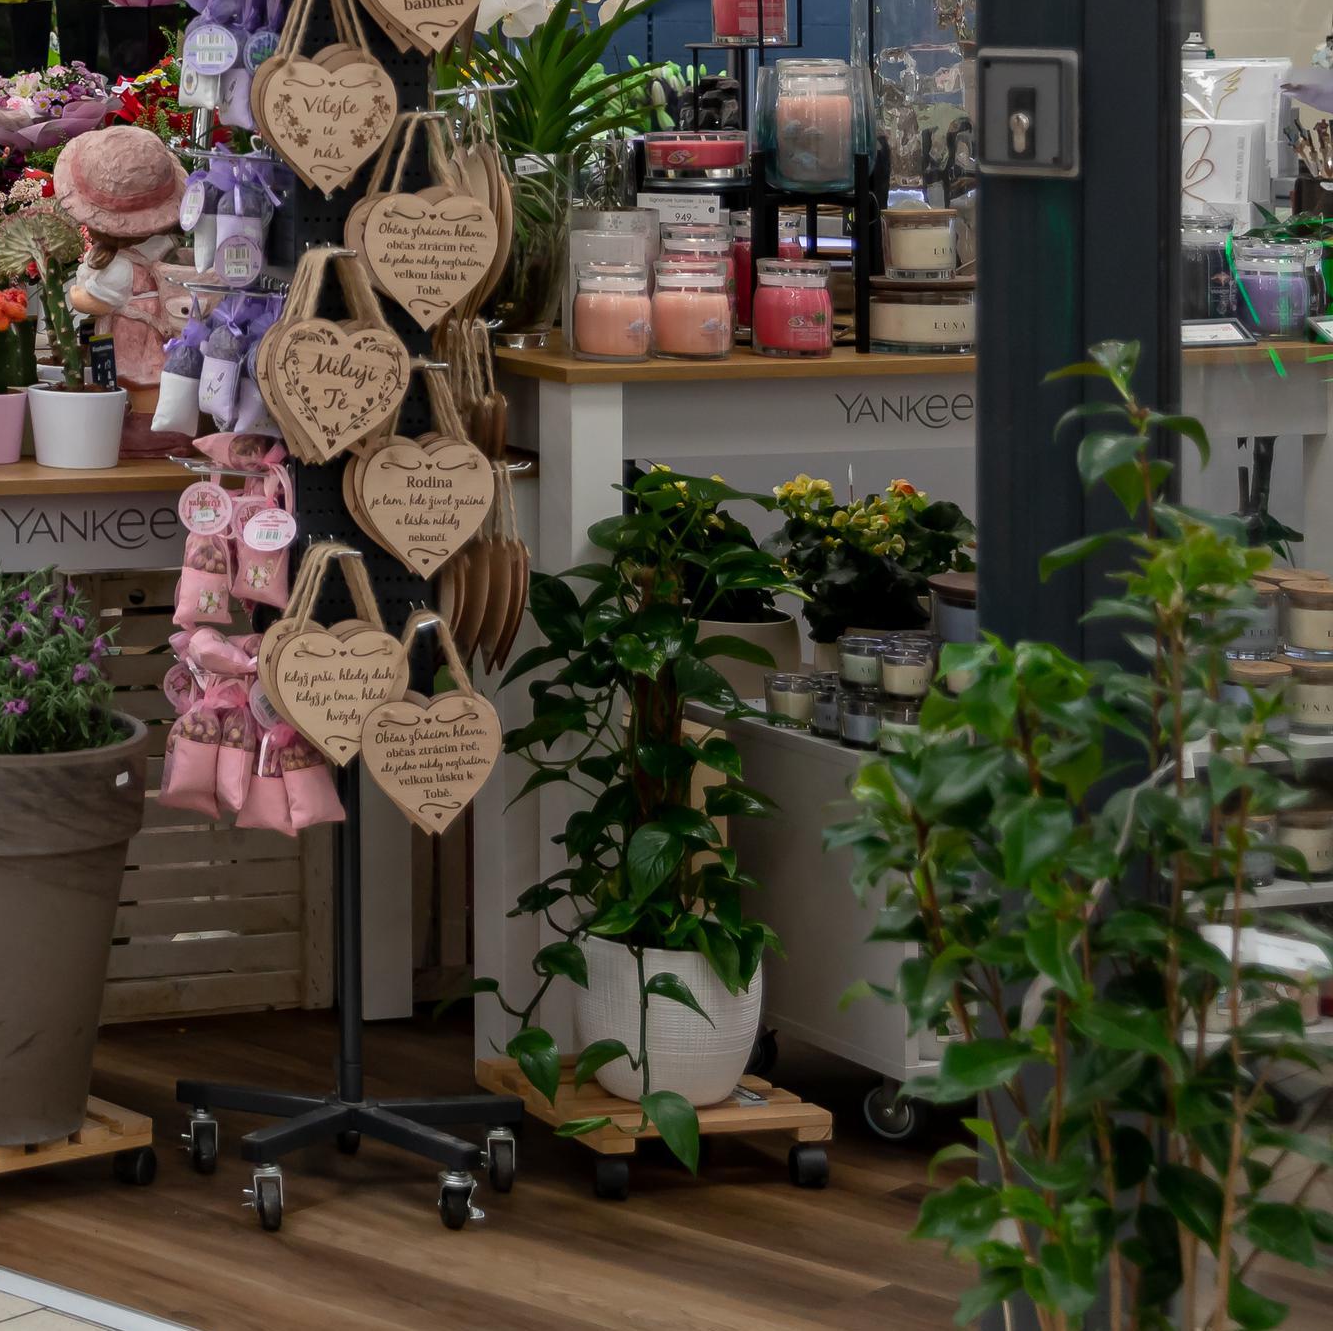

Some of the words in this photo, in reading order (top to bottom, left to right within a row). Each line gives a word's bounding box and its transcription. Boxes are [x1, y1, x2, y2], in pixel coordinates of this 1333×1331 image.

[303, 94, 360, 121] Vítejte
[323, 126, 336, 136] u
[313, 143, 345, 159] nás
[379, 222, 410, 235] Občas
[411, 224, 453, 241] ztrácím
[386, 240, 415, 250] občas
[418, 241, 457, 252] ztrácím
[416, 254, 440, 269] nikdy
[394, 270, 428, 280] velkou
[430, 270, 457, 281] lásku
[460, 272, 467, 281] k
[307, 354, 377, 389] Miluji
[323, 388, 349, 410] Tě
[406, 476, 453, 488] Rodina
[369, 497, 381, 510] je
[409, 493, 427, 506] kde
[428, 494, 453, 510] život
[453, 495, 486, 510] začíná
[404, 513, 430, 525] láska
[432, 513, 460, 530] nikdy
[284, 671, 309, 686] Když
[339, 667, 369, 684] hledej
[371, 667, 395, 680] duh
[296, 690, 321, 706] Když
[321, 692, 332, 706] je
[361, 687, 387, 701] hled
[375, 731, 407, 744] Občas
[408, 729, 451, 745] ztrácím
[386, 747, 416, 759] občas
[418, 744, 458, 757] ztrácím
[393, 760, 417, 775] jedno
[418, 759, 444, 772] nikdy
[398, 773, 433, 786] velkou
[436, 771, 464, 783] lásku
[466, 770, 473, 780] k
